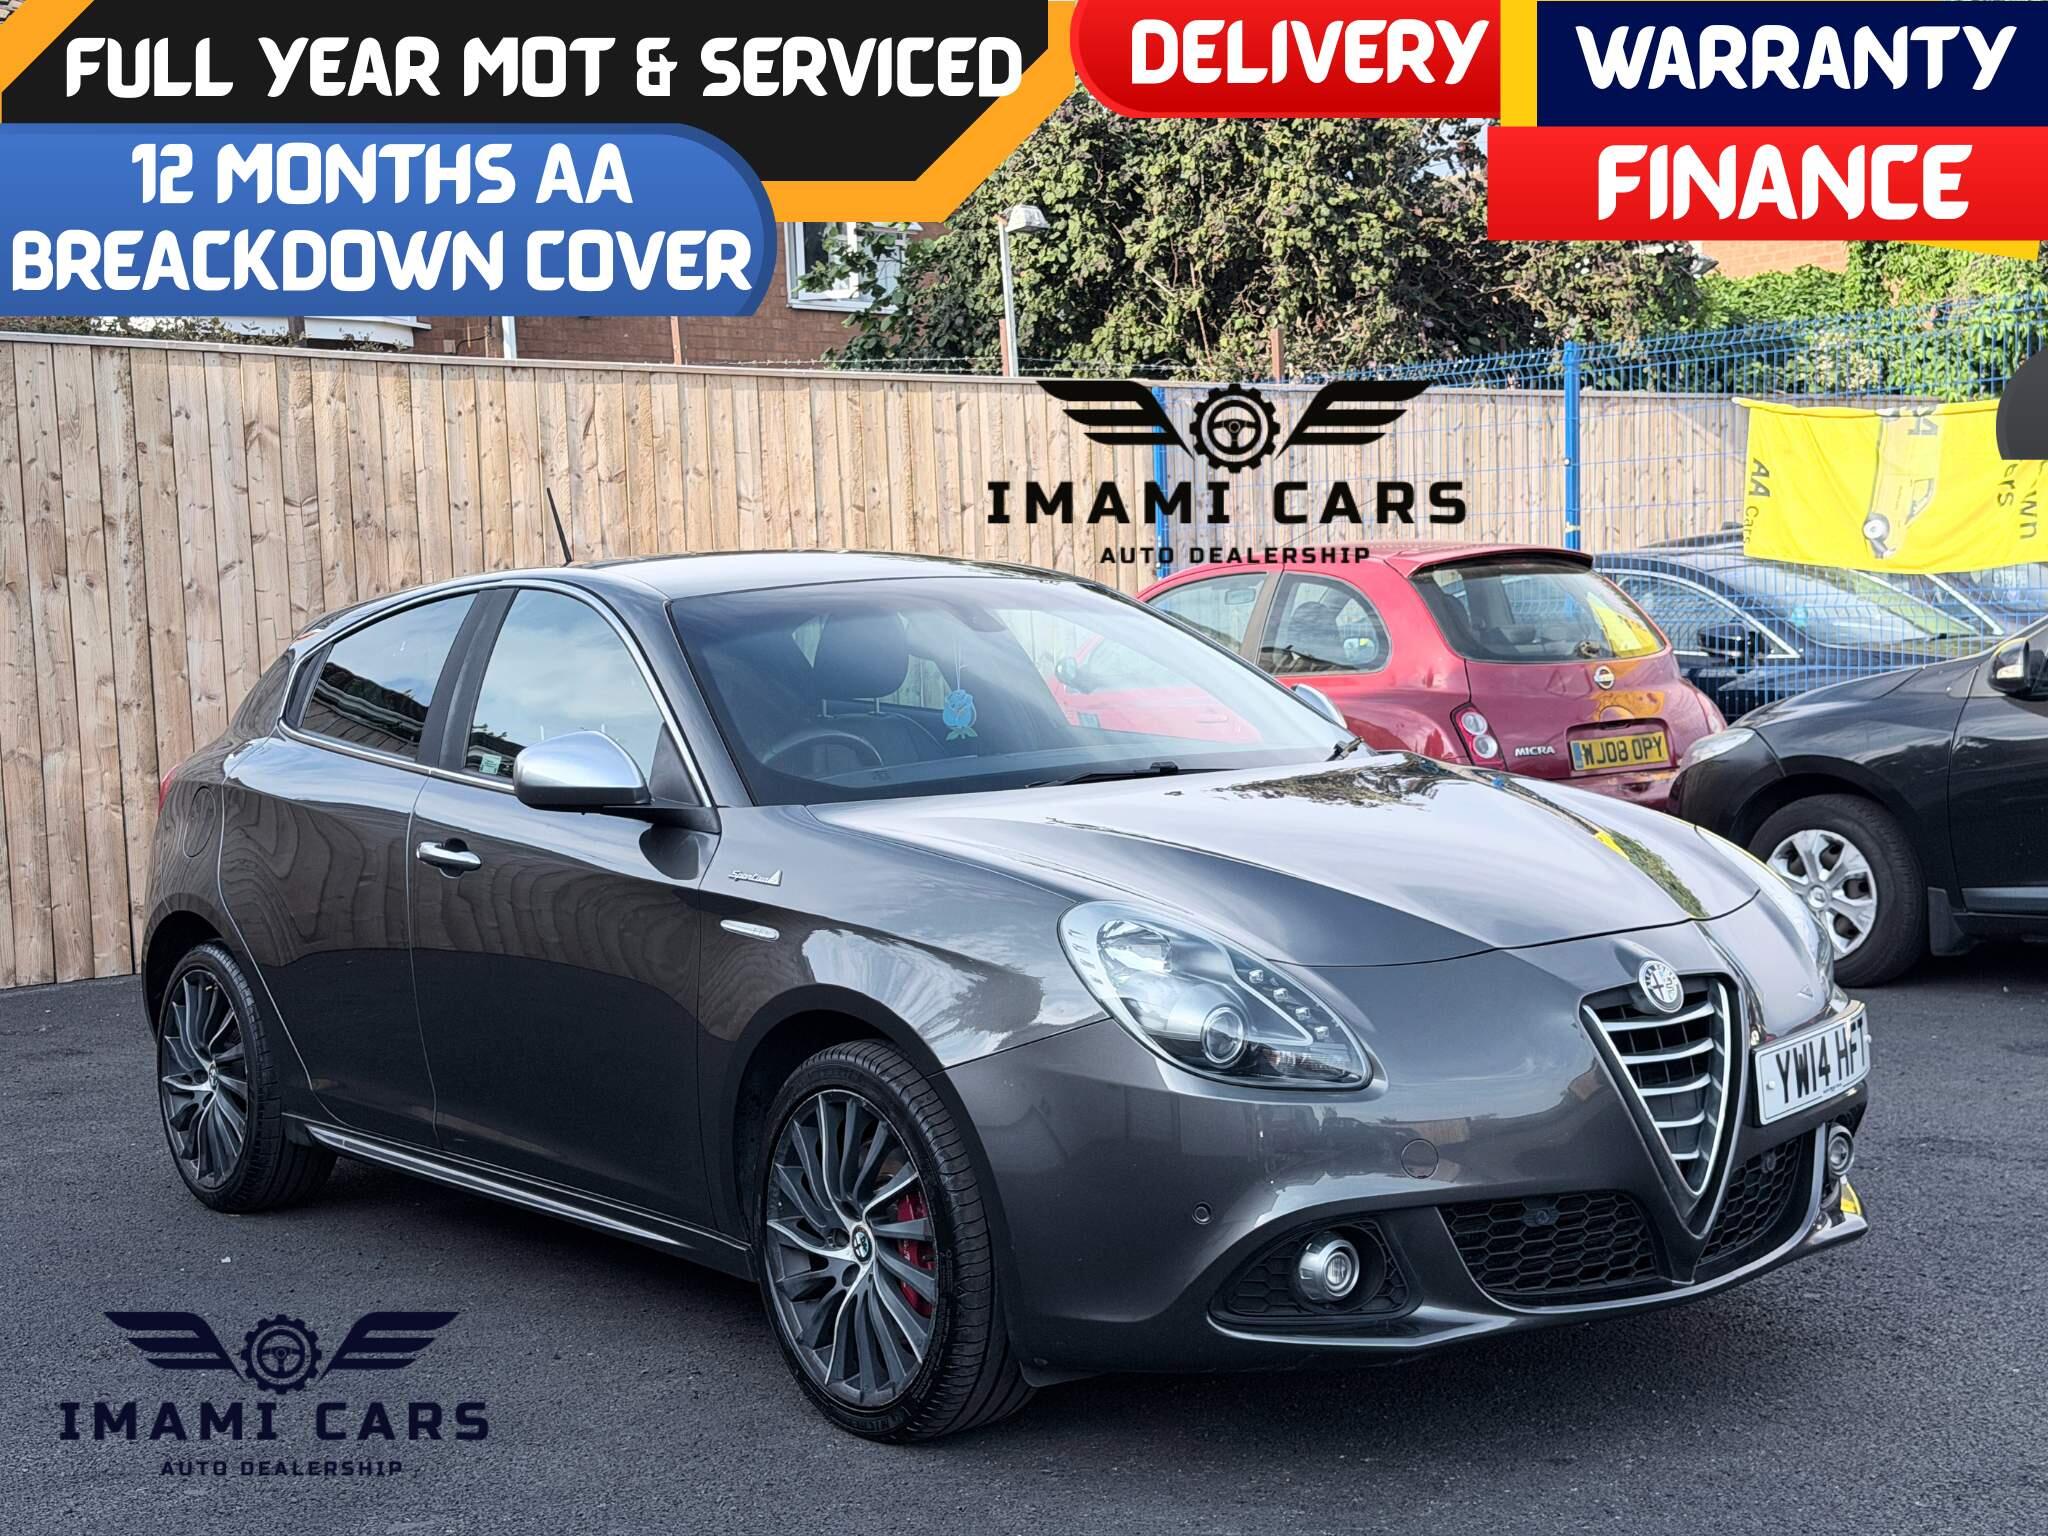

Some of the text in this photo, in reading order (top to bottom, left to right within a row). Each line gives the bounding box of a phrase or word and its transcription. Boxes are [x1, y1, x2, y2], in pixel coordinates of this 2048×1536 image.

[1748, 457, 1770, 496] AA
[1514, 745, 1556, 757] MICRA
[1776, 1036, 1831, 1104] YW14
